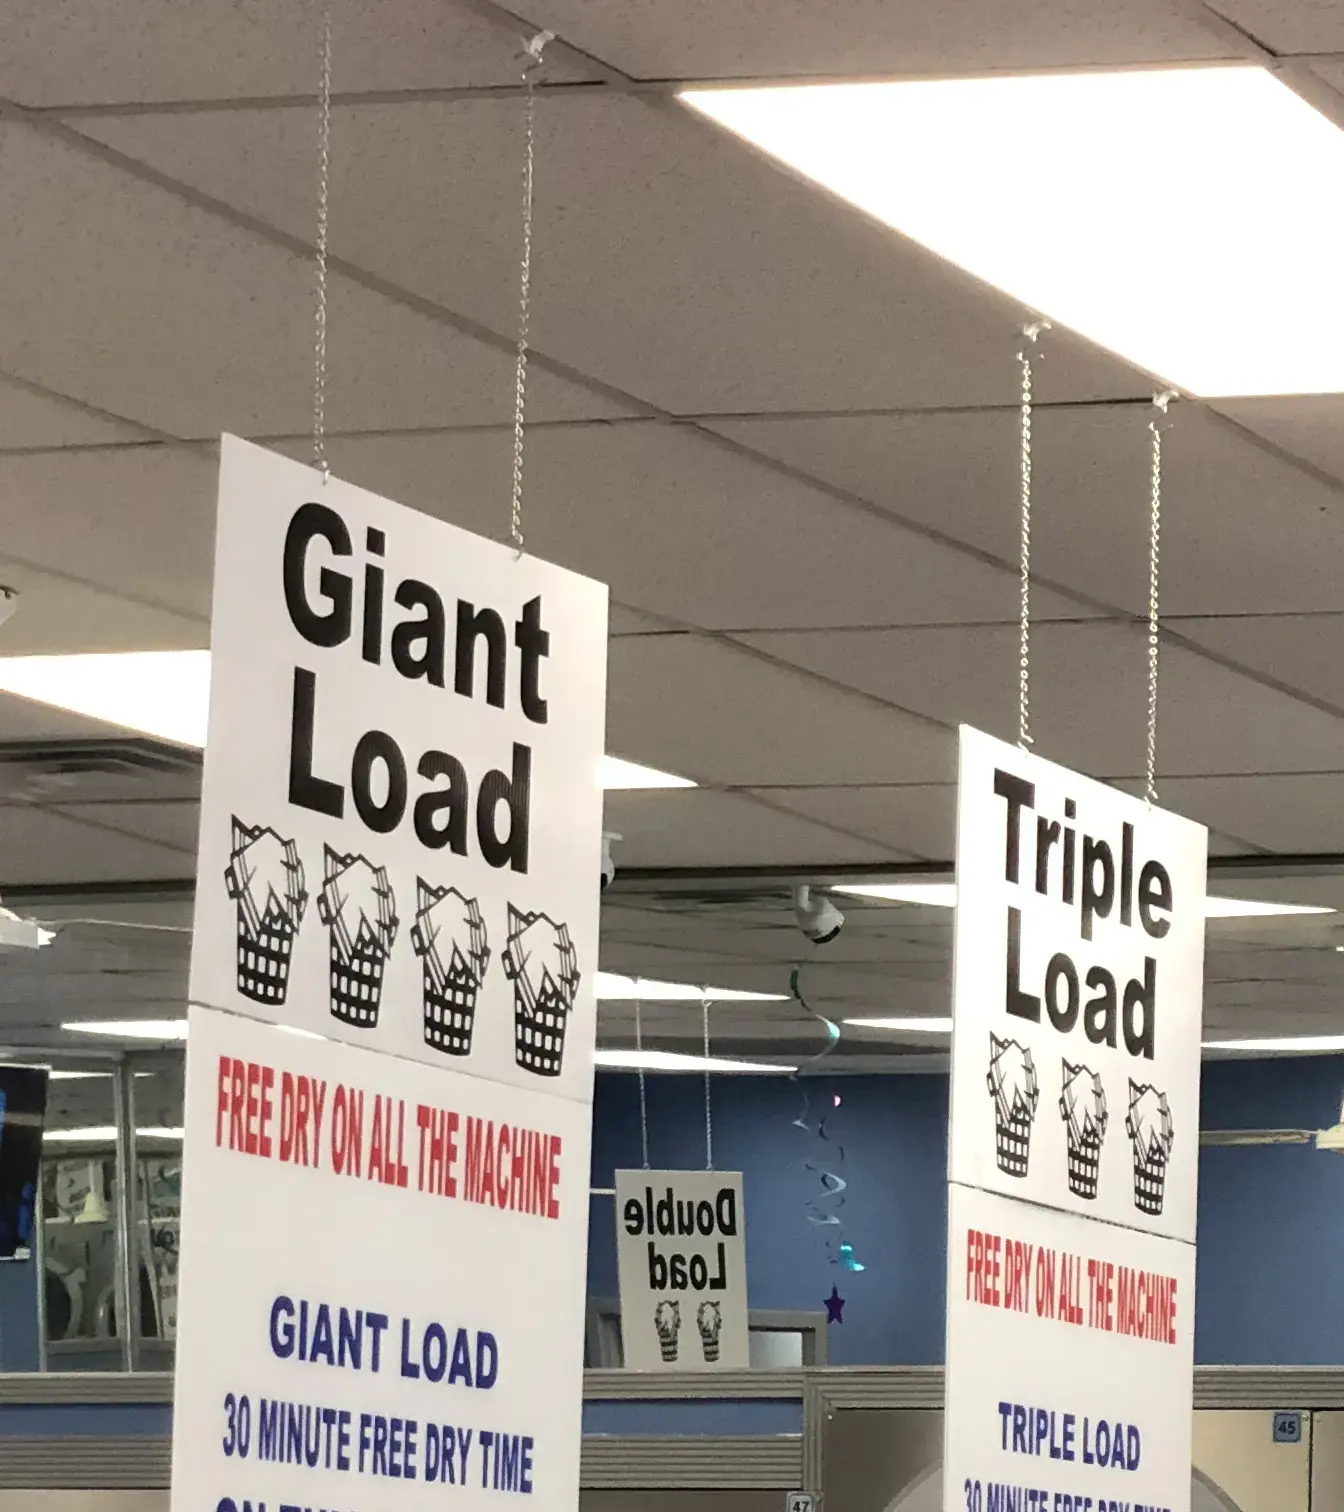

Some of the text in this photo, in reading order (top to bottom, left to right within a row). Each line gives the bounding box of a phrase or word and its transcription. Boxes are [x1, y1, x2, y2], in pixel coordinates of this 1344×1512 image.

[283, 503, 549, 724] Giant
[288, 666, 531, 874] Load
[994, 768, 1172, 941] Triple
[1006, 906, 1156, 1060] Load
[217, 1056, 561, 1219] FREE DRY ON ALL THE MACHINE
[270, 1296, 498, 1389] GIANT LOAD
[967, 1229, 1177, 1344] FREE DRY ON ALL THE MACHINE
[223, 1393, 533, 1493] 30 MINUTE FREE DRY TIME
[999, 1402, 1140, 1471] TRIPLE LOAD
[1278, 1421, 1295, 1435] 45
